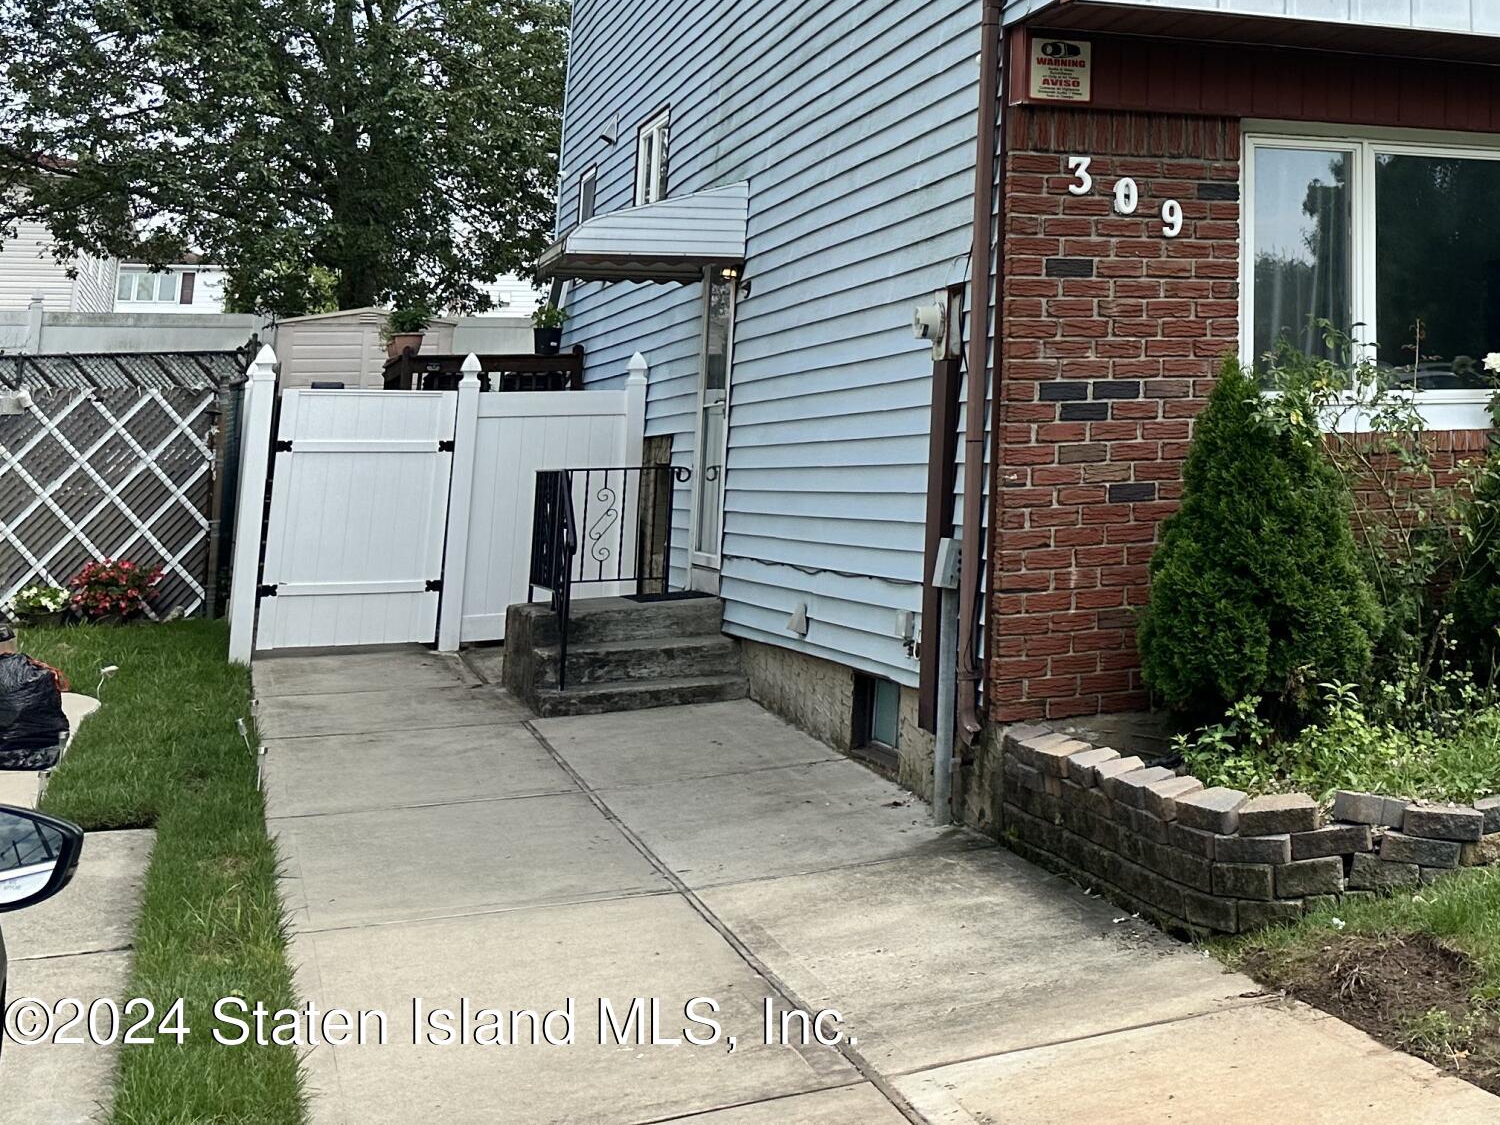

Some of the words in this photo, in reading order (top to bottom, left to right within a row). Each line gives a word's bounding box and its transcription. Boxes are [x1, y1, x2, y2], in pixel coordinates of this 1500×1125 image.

[1036, 57, 1086, 68] WARNING
[1042, 78, 1080, 87] AVISO
[1068, 156, 1183, 237] 309
